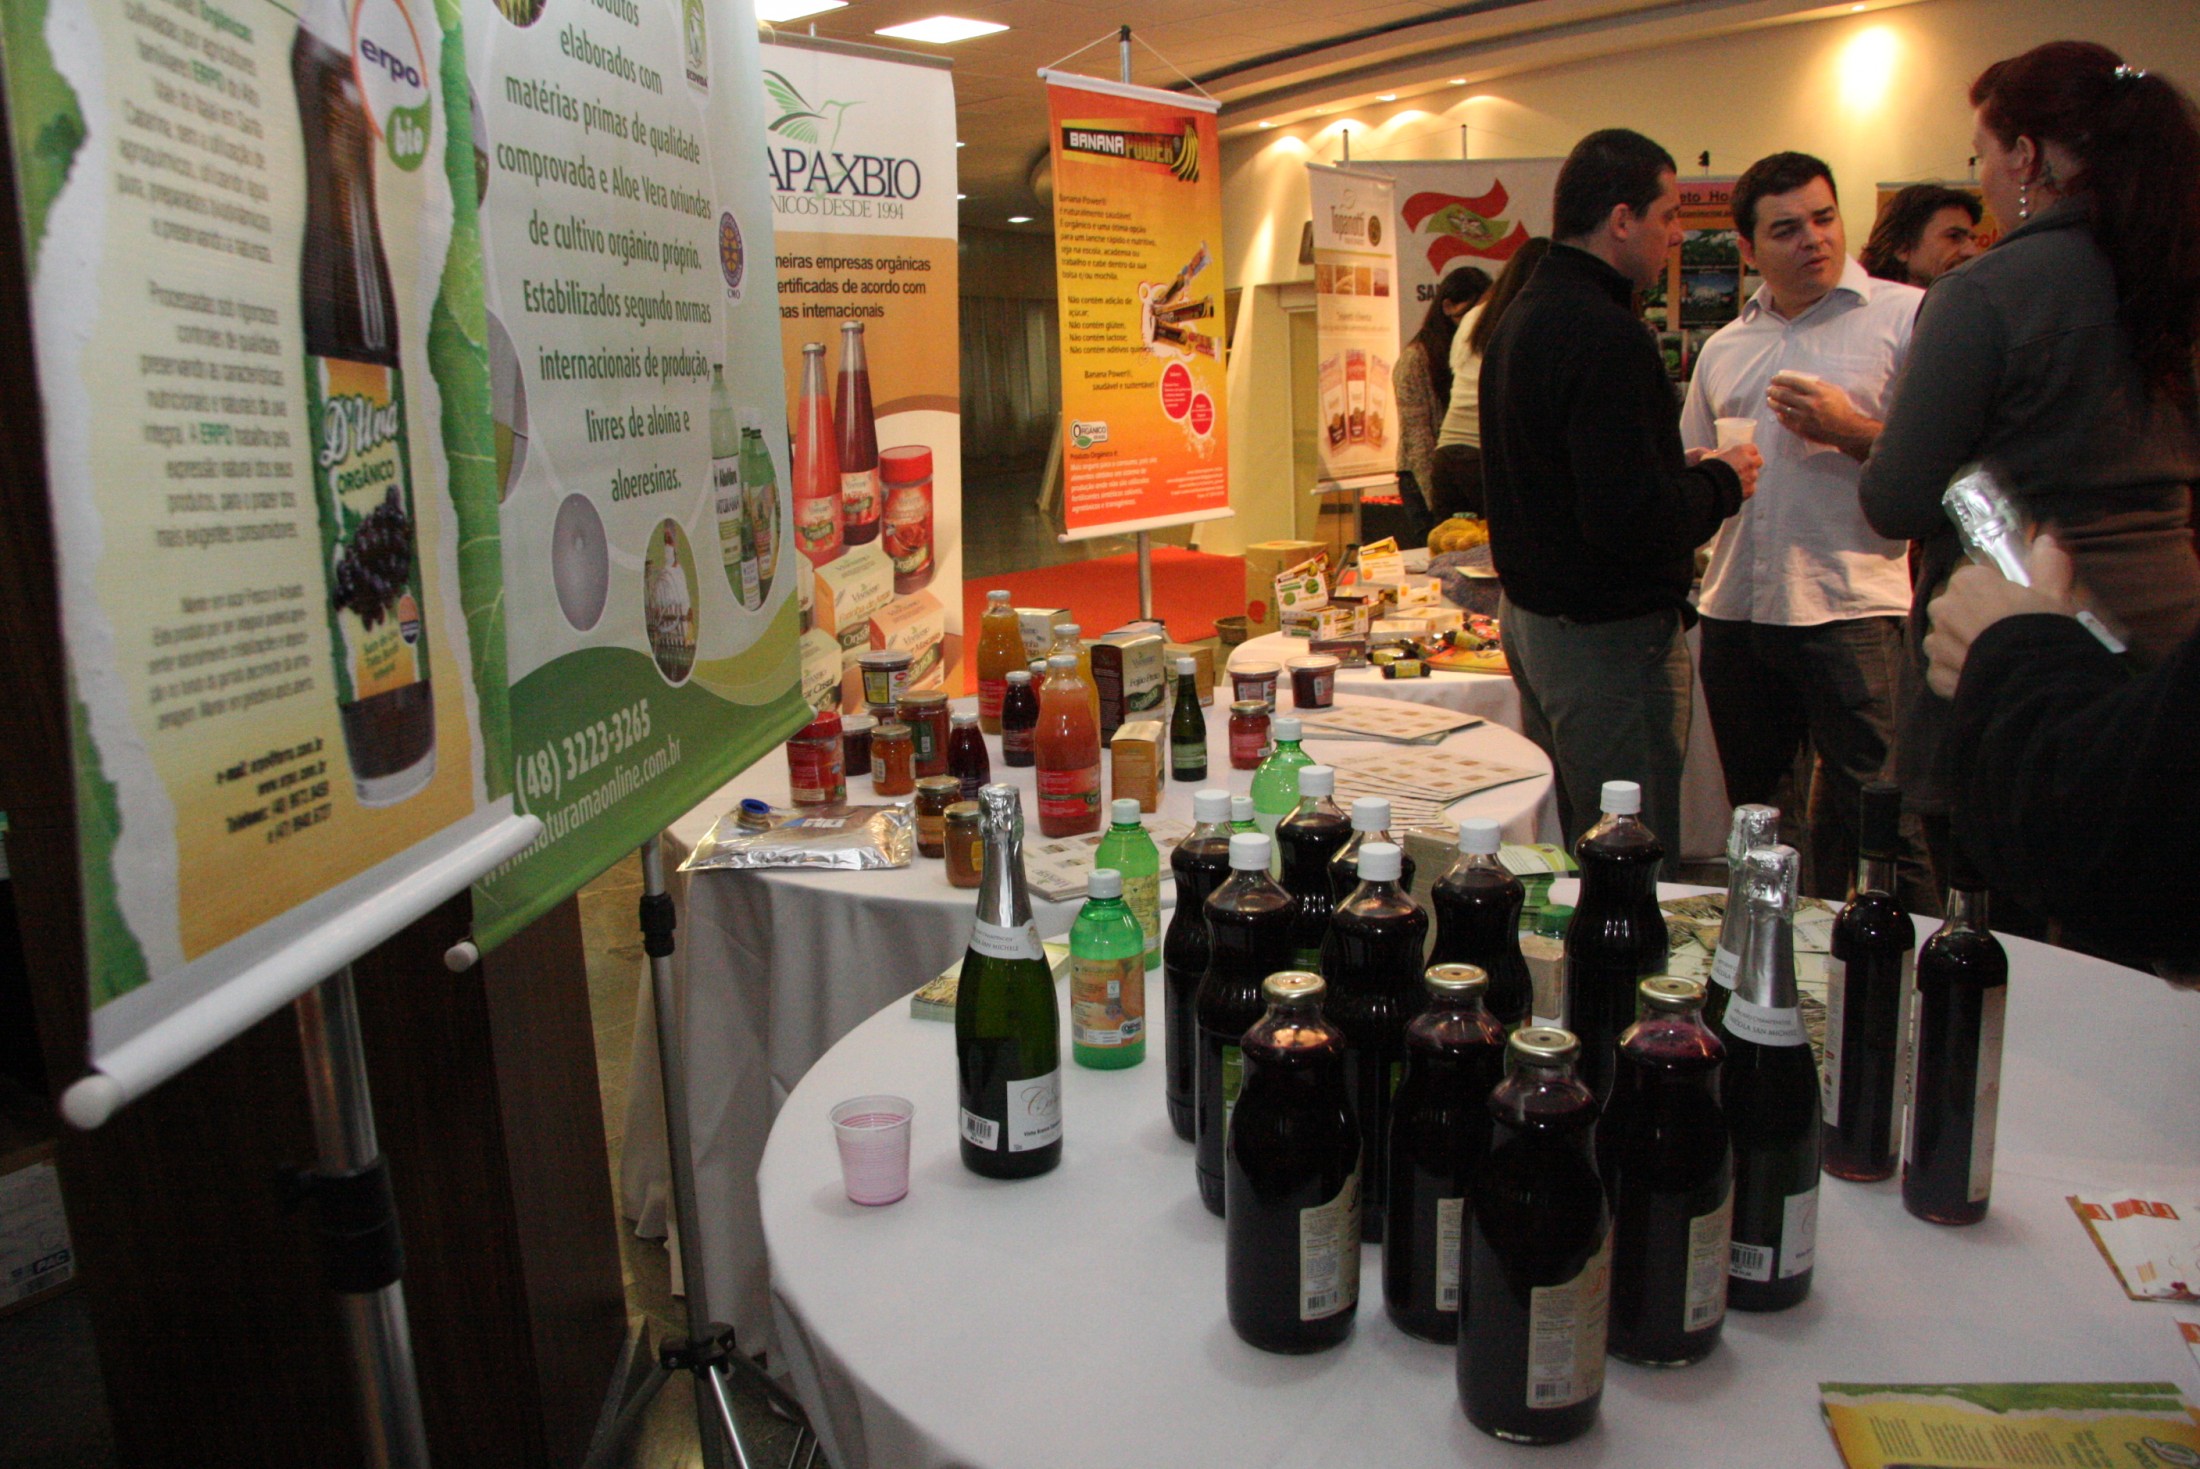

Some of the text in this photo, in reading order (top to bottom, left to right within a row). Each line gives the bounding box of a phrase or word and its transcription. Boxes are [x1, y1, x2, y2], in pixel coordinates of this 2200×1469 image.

[360, 35, 421, 88] erpo
[561, 23, 663, 95] elaborados com
[394, 117, 424, 157] bio
[505, 75, 701, 166] matérias primas de qualidade
[1069, 131, 1124, 155] BANANA
[497, 142, 711, 220] comprovada e Aloe Vera oriundas
[823, 198, 872, 218] DESDE
[876, 202, 904, 220] 1994
[528, 209, 702, 275] de cultivo orgânico próprio.
[816, 256, 873, 272] empresas
[876, 255, 931, 274] orgânicas
[523, 279, 712, 327] Estabilizados segundo normas
[842, 279, 858, 294] de
[860, 279, 899, 294] acordo
[902, 282, 926, 295] com
[802, 302, 884, 319] internacionais
[539, 345, 710, 384] internacionais de produção,
[586, 404, 690, 443] livres de aloína e
[611, 463, 682, 502] aloeresinas.
[516, 698, 651, 815] (48) 3223-3265
[484, 734, 682, 888] aturamaonline.com.br
